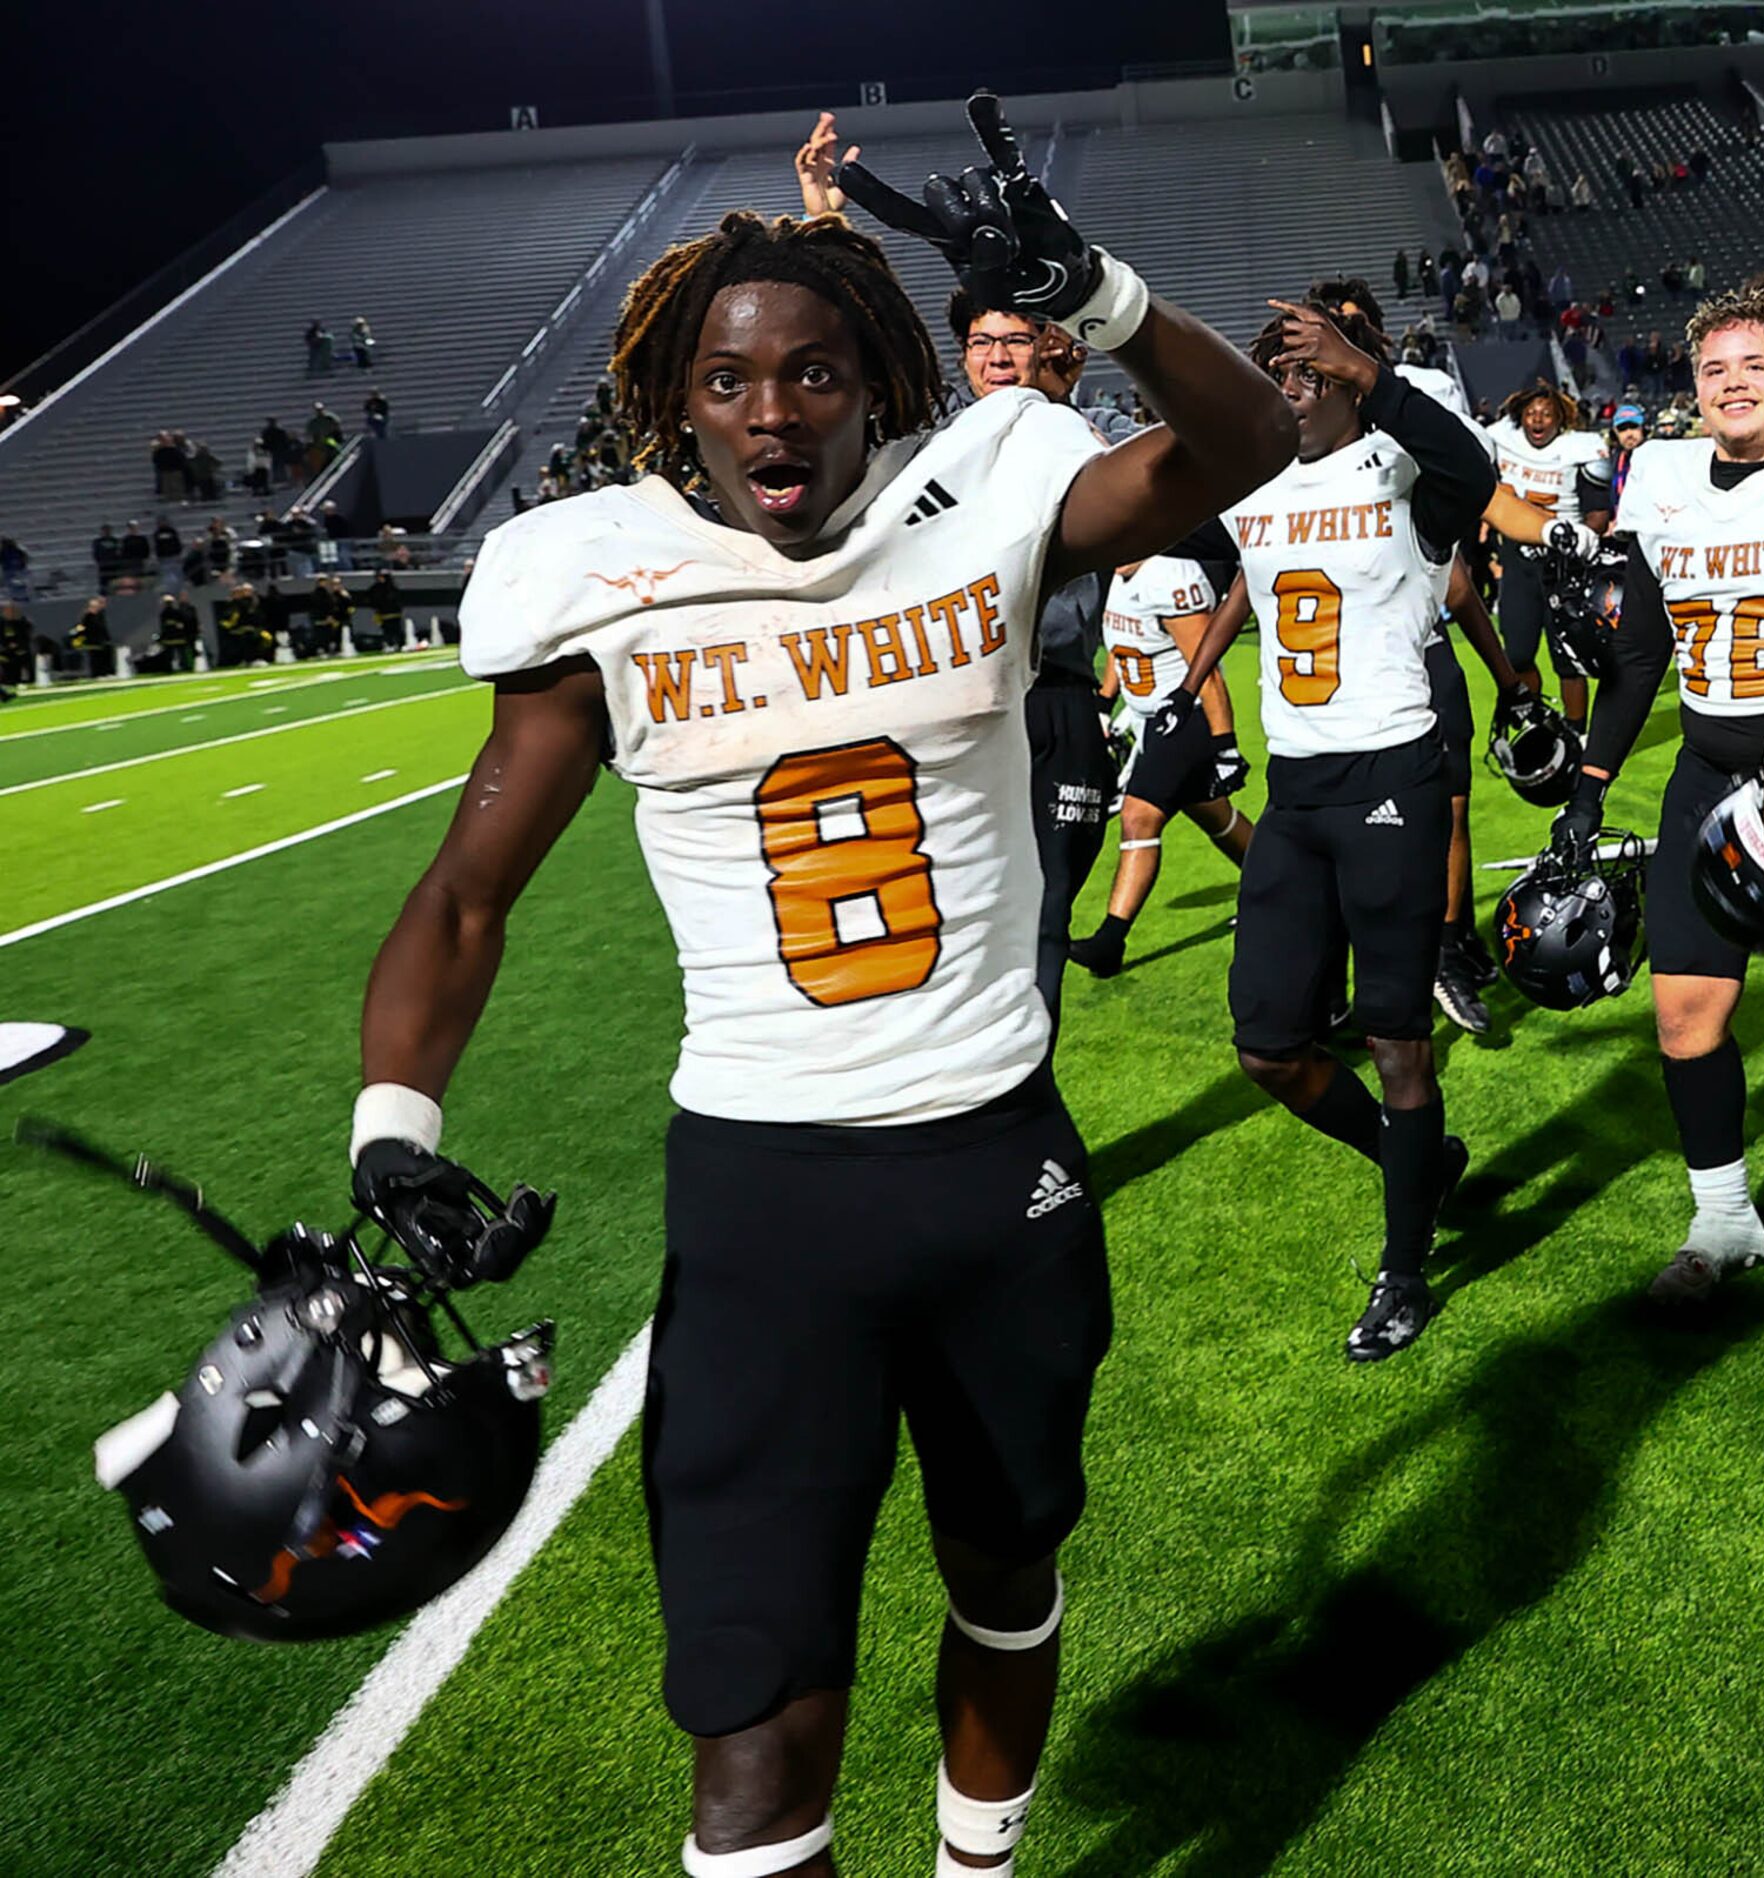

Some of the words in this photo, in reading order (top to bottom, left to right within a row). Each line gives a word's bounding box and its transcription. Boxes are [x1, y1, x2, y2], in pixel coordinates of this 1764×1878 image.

[865, 83, 883, 106] B
[1233, 78, 1253, 100] C
[515, 107, 536, 129] A
[1287, 500, 1393, 545] WHITE
[1659, 545, 1696, 578] W.T.
[632, 642, 768, 723] W.T.
[780, 572, 1007, 701] WHITE
[1272, 568, 1343, 707] 9
[1365, 814, 1404, 827] adidas
[753, 735, 944, 1008] 8
[1026, 1182, 1083, 1218] adidas
